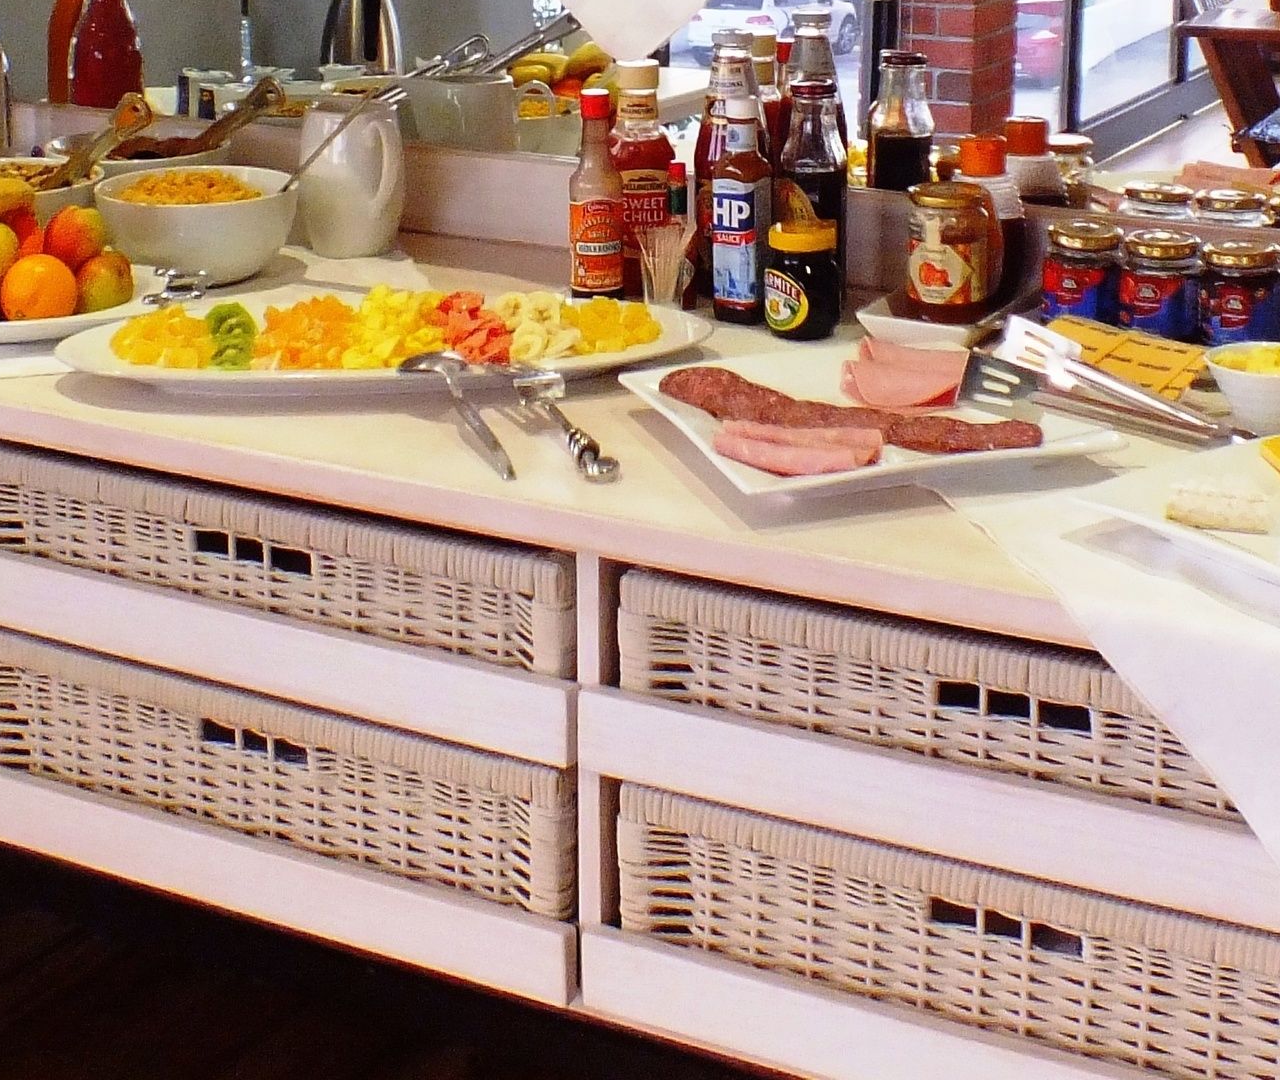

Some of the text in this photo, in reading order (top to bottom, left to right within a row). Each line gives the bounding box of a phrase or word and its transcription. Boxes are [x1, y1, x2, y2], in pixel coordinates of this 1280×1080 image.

[623, 197, 666, 210] SWEET
[623, 210, 664, 223] CHILLI
[713, 196, 751, 229] HP
[716, 233, 741, 242] SAUCE
